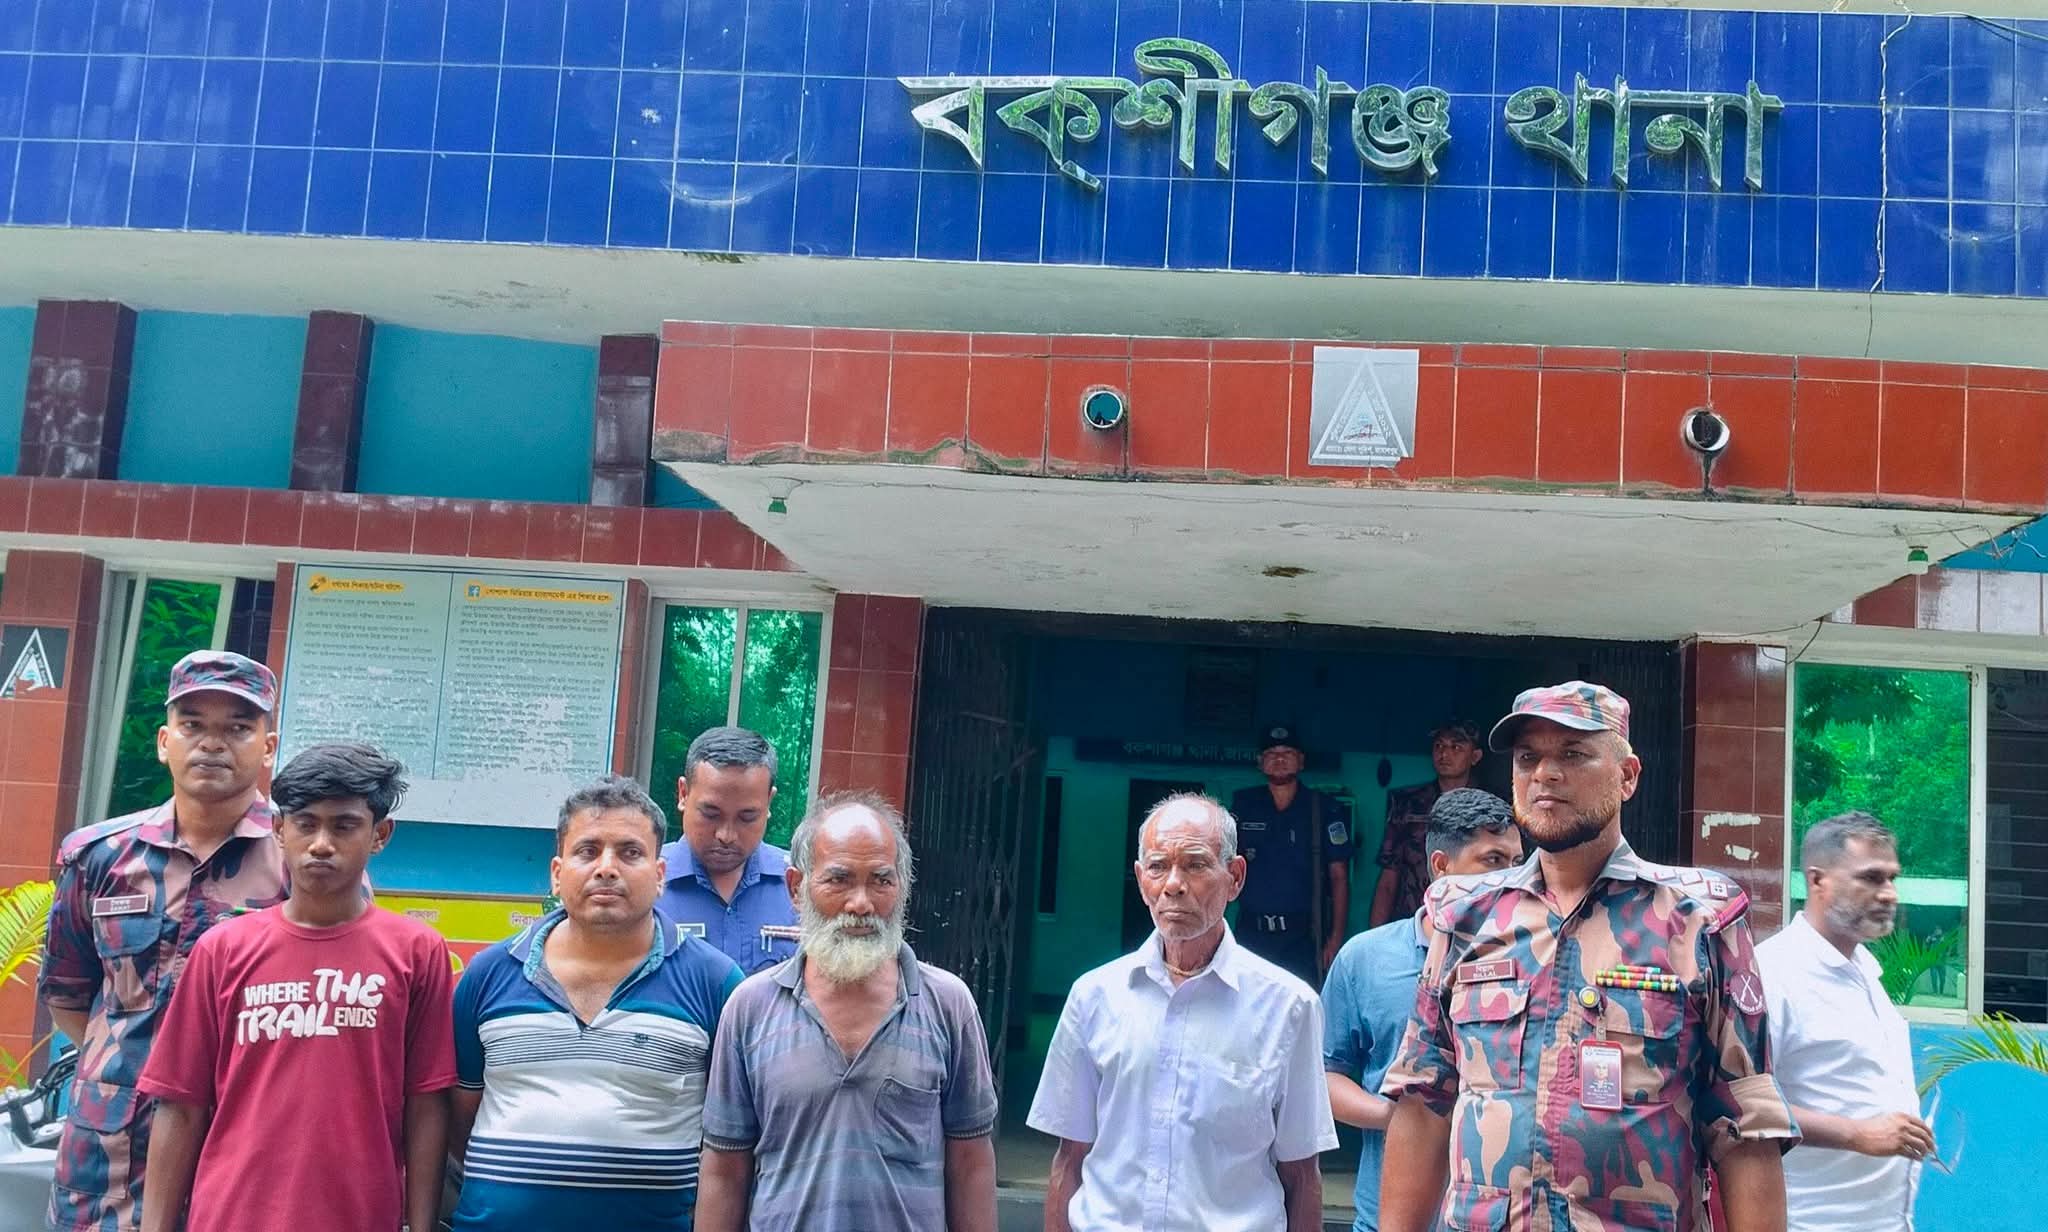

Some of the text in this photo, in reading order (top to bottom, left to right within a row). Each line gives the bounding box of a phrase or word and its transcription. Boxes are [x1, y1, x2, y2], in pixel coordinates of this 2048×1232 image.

[1504, 72, 1784, 191] থানা
[244, 967, 386, 1008] WHERE THE
[237, 1001, 378, 1046] TRAIL ENDS
